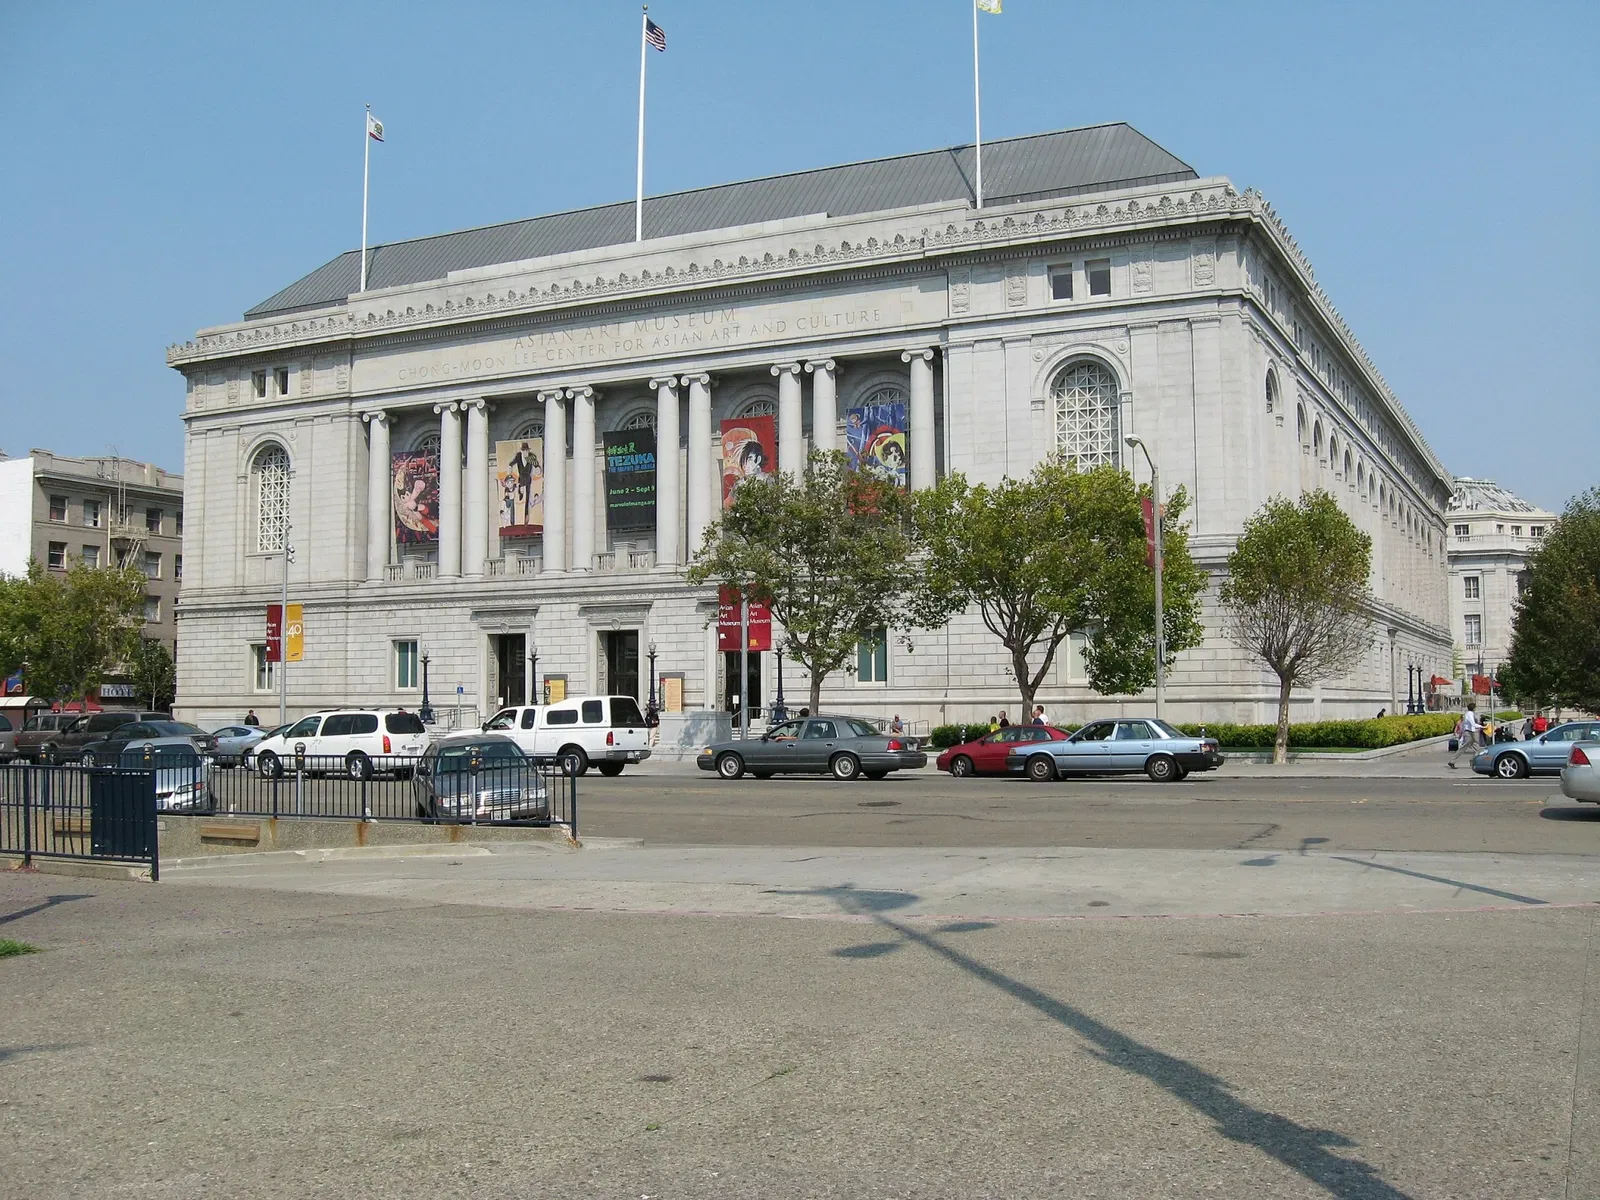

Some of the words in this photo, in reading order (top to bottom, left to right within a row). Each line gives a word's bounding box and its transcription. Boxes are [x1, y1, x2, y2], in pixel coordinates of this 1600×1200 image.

[514, 328, 574, 349] ASIAN
[584, 322, 624, 341] ART
[634, 308, 736, 333] MUSEUM
[398, 356, 506, 381] CHONG-MOON
[514, 353, 537, 366] LEE
[545, 343, 606, 361] CENTER
[614, 338, 645, 353] FOR
[652, 330, 703, 348] ASIAN
[710, 326, 741, 341] ART
[750, 320, 787, 336] AND
[796, 309, 881, 330] CULTURE
[608, 453, 655, 466] TEZUKA
[288, 624, 302, 638] 40
